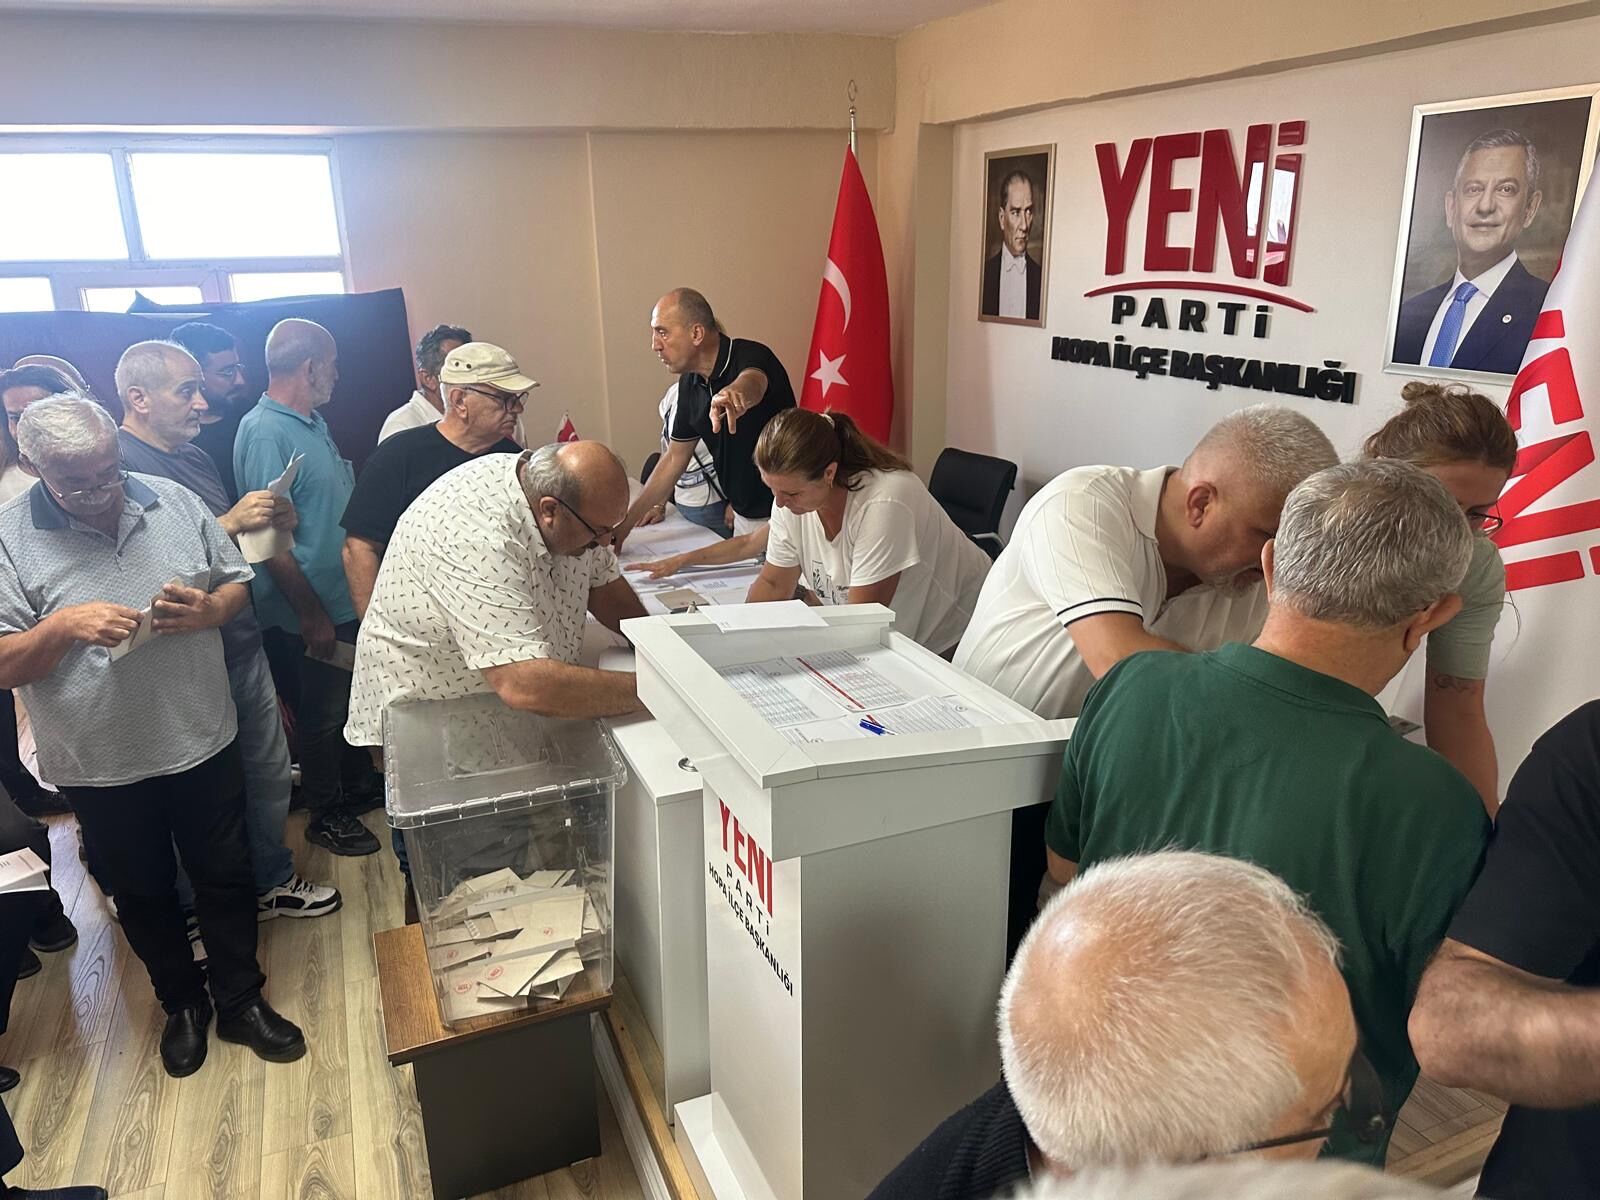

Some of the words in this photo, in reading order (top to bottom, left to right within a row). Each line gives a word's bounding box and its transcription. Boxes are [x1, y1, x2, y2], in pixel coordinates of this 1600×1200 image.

[1051, 336, 1112, 368] HOPA
[1112, 335, 1169, 379] İLÇE
[1169, 350, 1357, 403] BAŞKANLIĞI
[708, 862, 728, 900] HOPA
[728, 887, 744, 924] İLÇE
[745, 916, 794, 997] BAŞKANLIĞI
